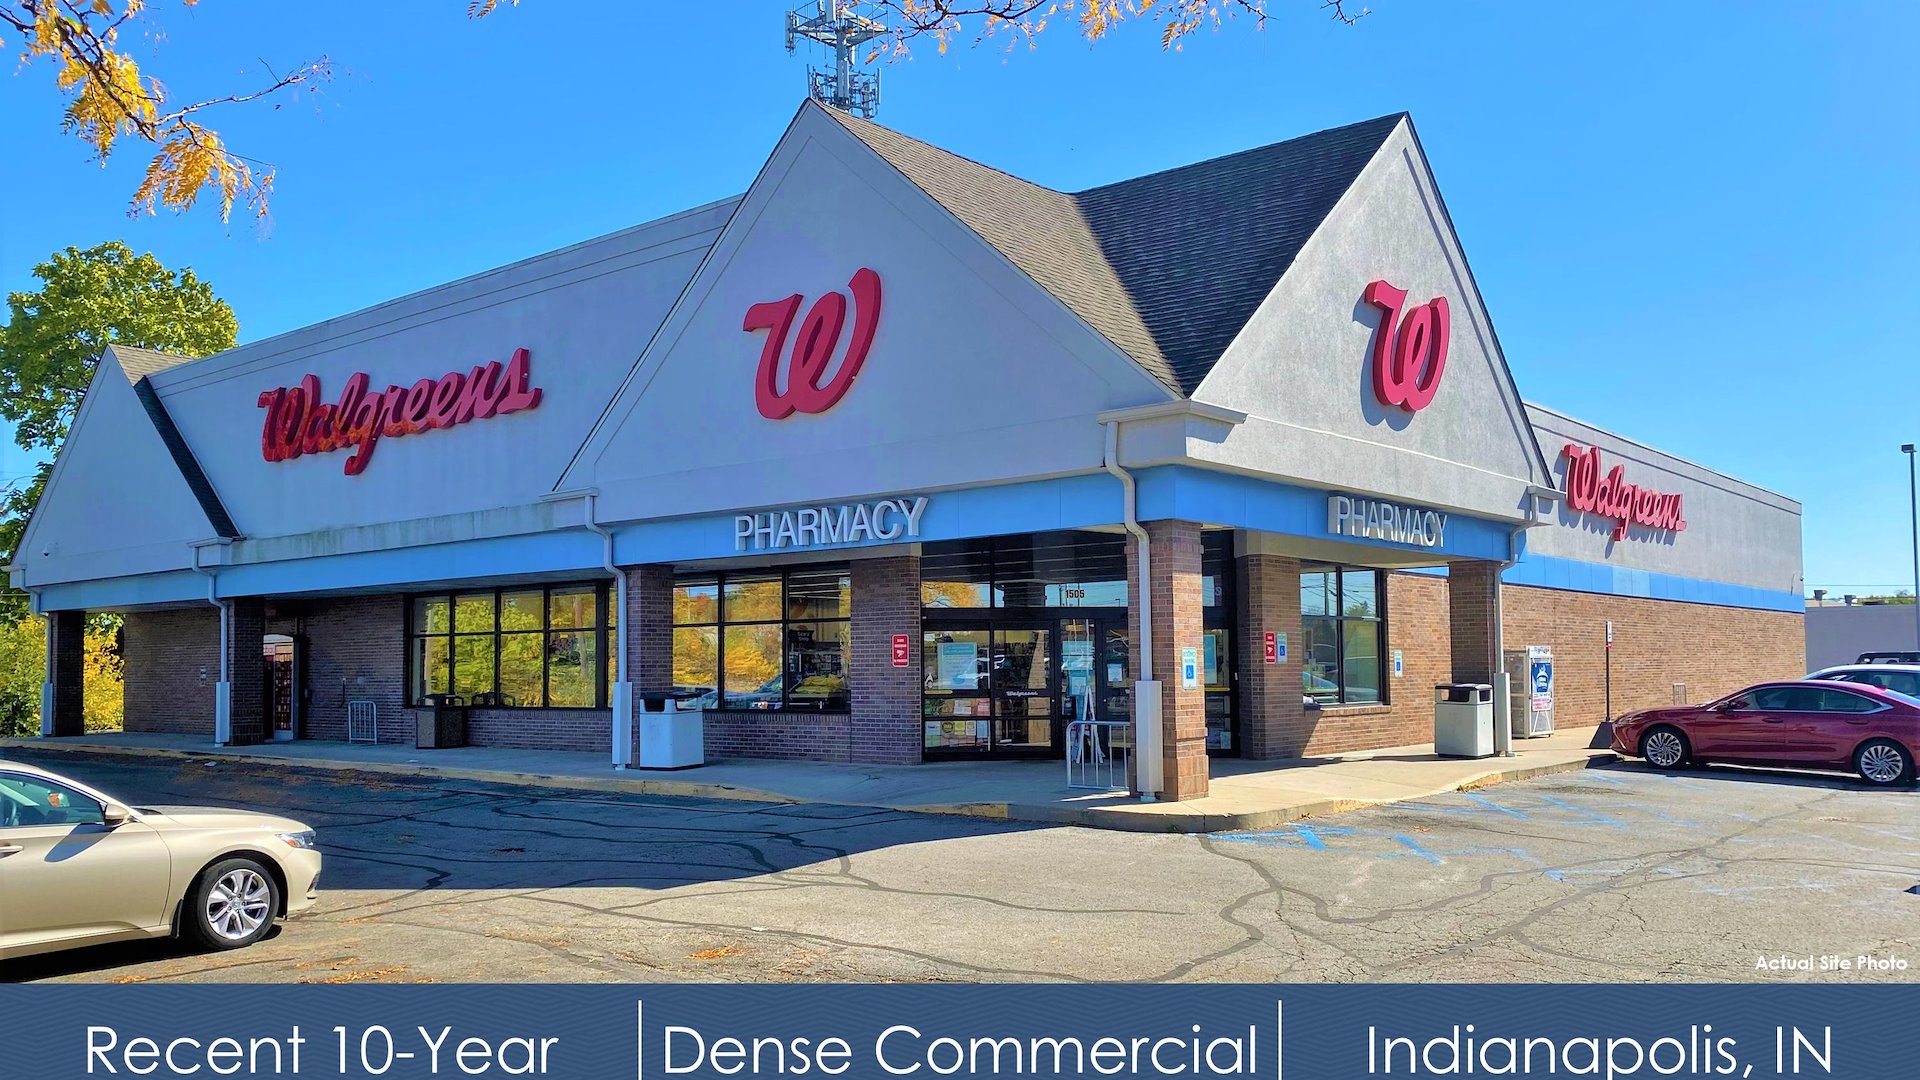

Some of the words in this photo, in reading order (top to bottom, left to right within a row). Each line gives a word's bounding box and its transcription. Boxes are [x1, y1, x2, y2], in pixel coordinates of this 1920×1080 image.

[743, 267, 882, 420] W
[1365, 279, 1451, 412] W
[257, 347, 543, 476] Walgreens
[735, 497, 929, 551] PHARMACY
[1334, 495, 1448, 548] PHARMACY
[1564, 443, 1687, 542] Walgreens
[1065, 589, 1085, 599] 1505
